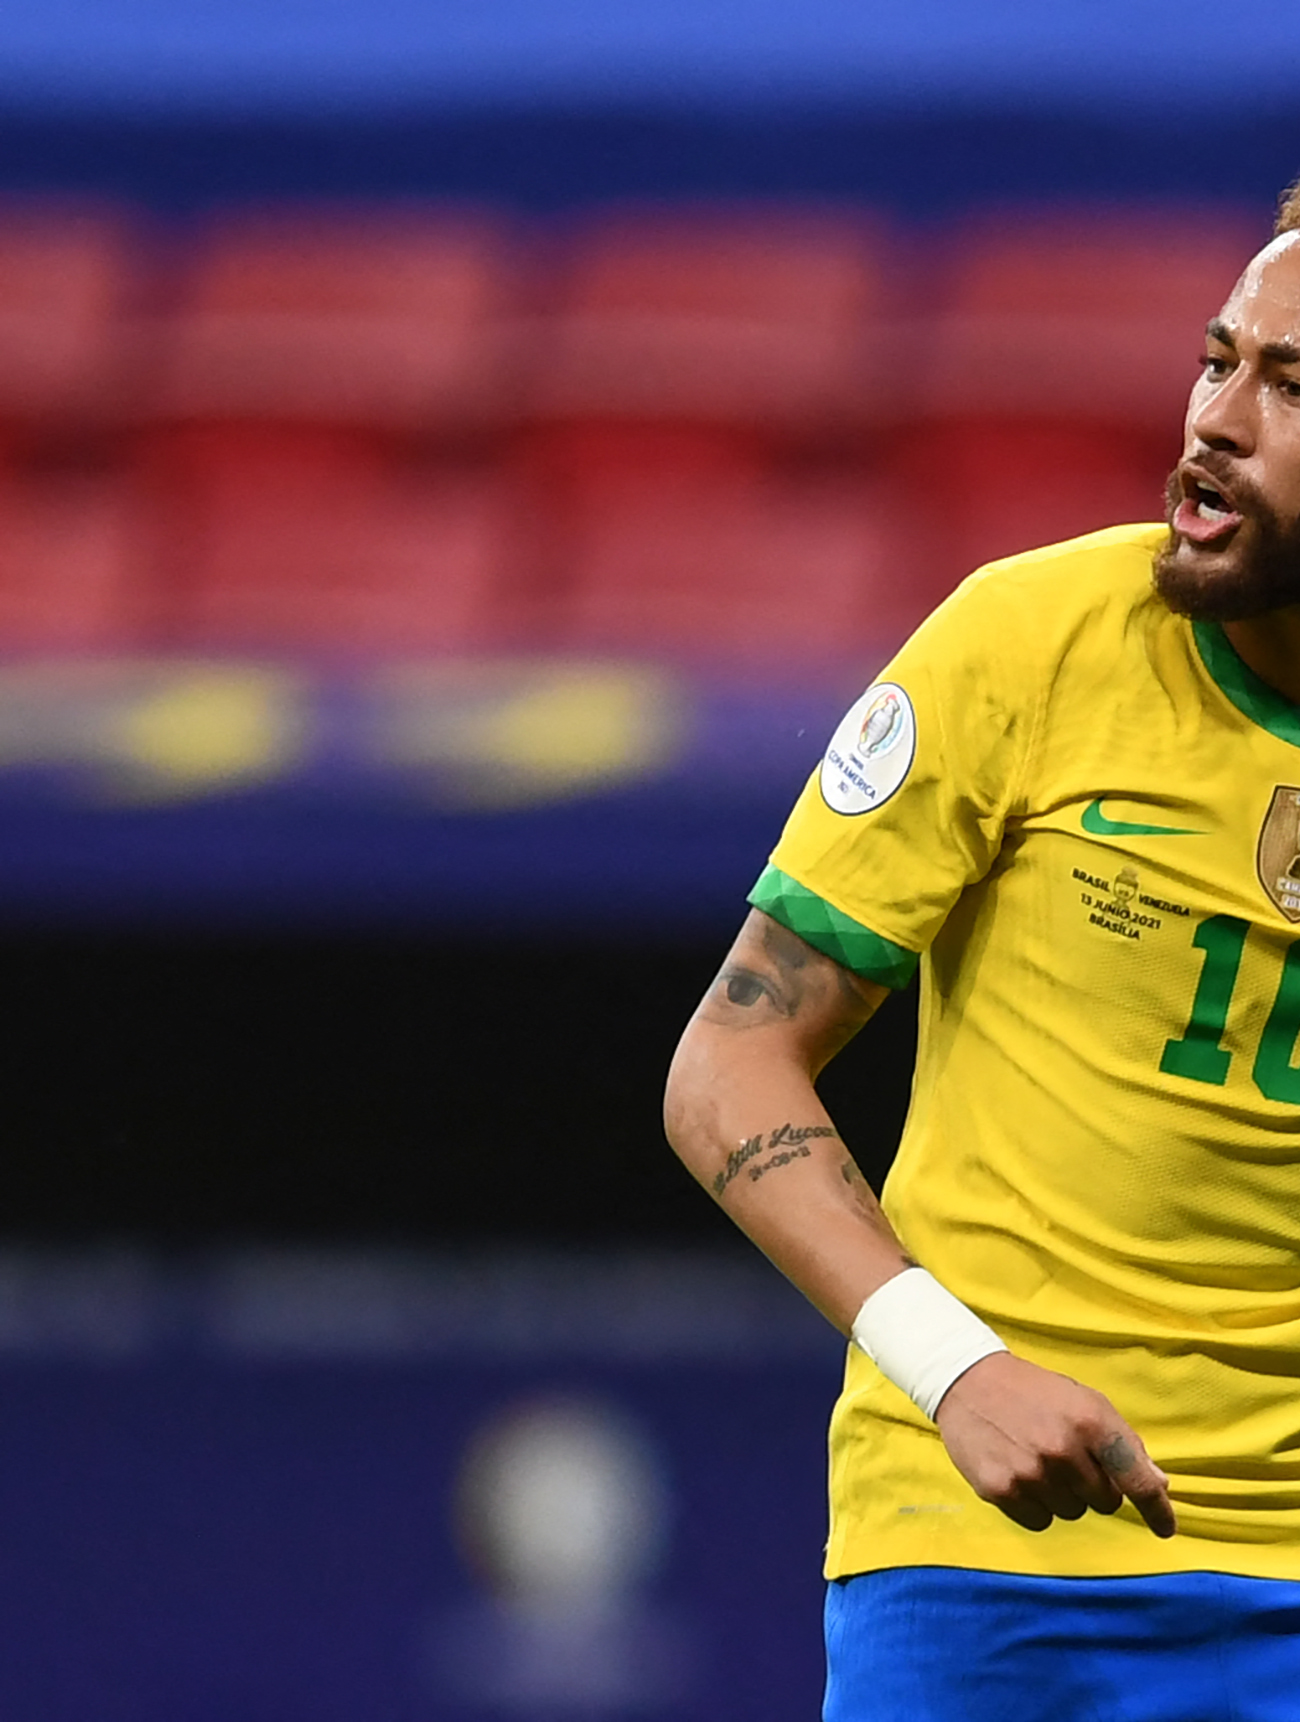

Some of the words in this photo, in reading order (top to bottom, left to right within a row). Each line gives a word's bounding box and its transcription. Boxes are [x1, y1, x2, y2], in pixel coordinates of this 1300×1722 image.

[1072, 867, 1110, 892] BRASIL
[1139, 894, 1190, 917] VENEZUELA
[1081, 892, 1092, 906] 13
[1093, 900, 1130, 919] JUNIO
[1130, 913, 1161, 930] 2021
[1089, 912, 1140, 940] BRASÍLIA
